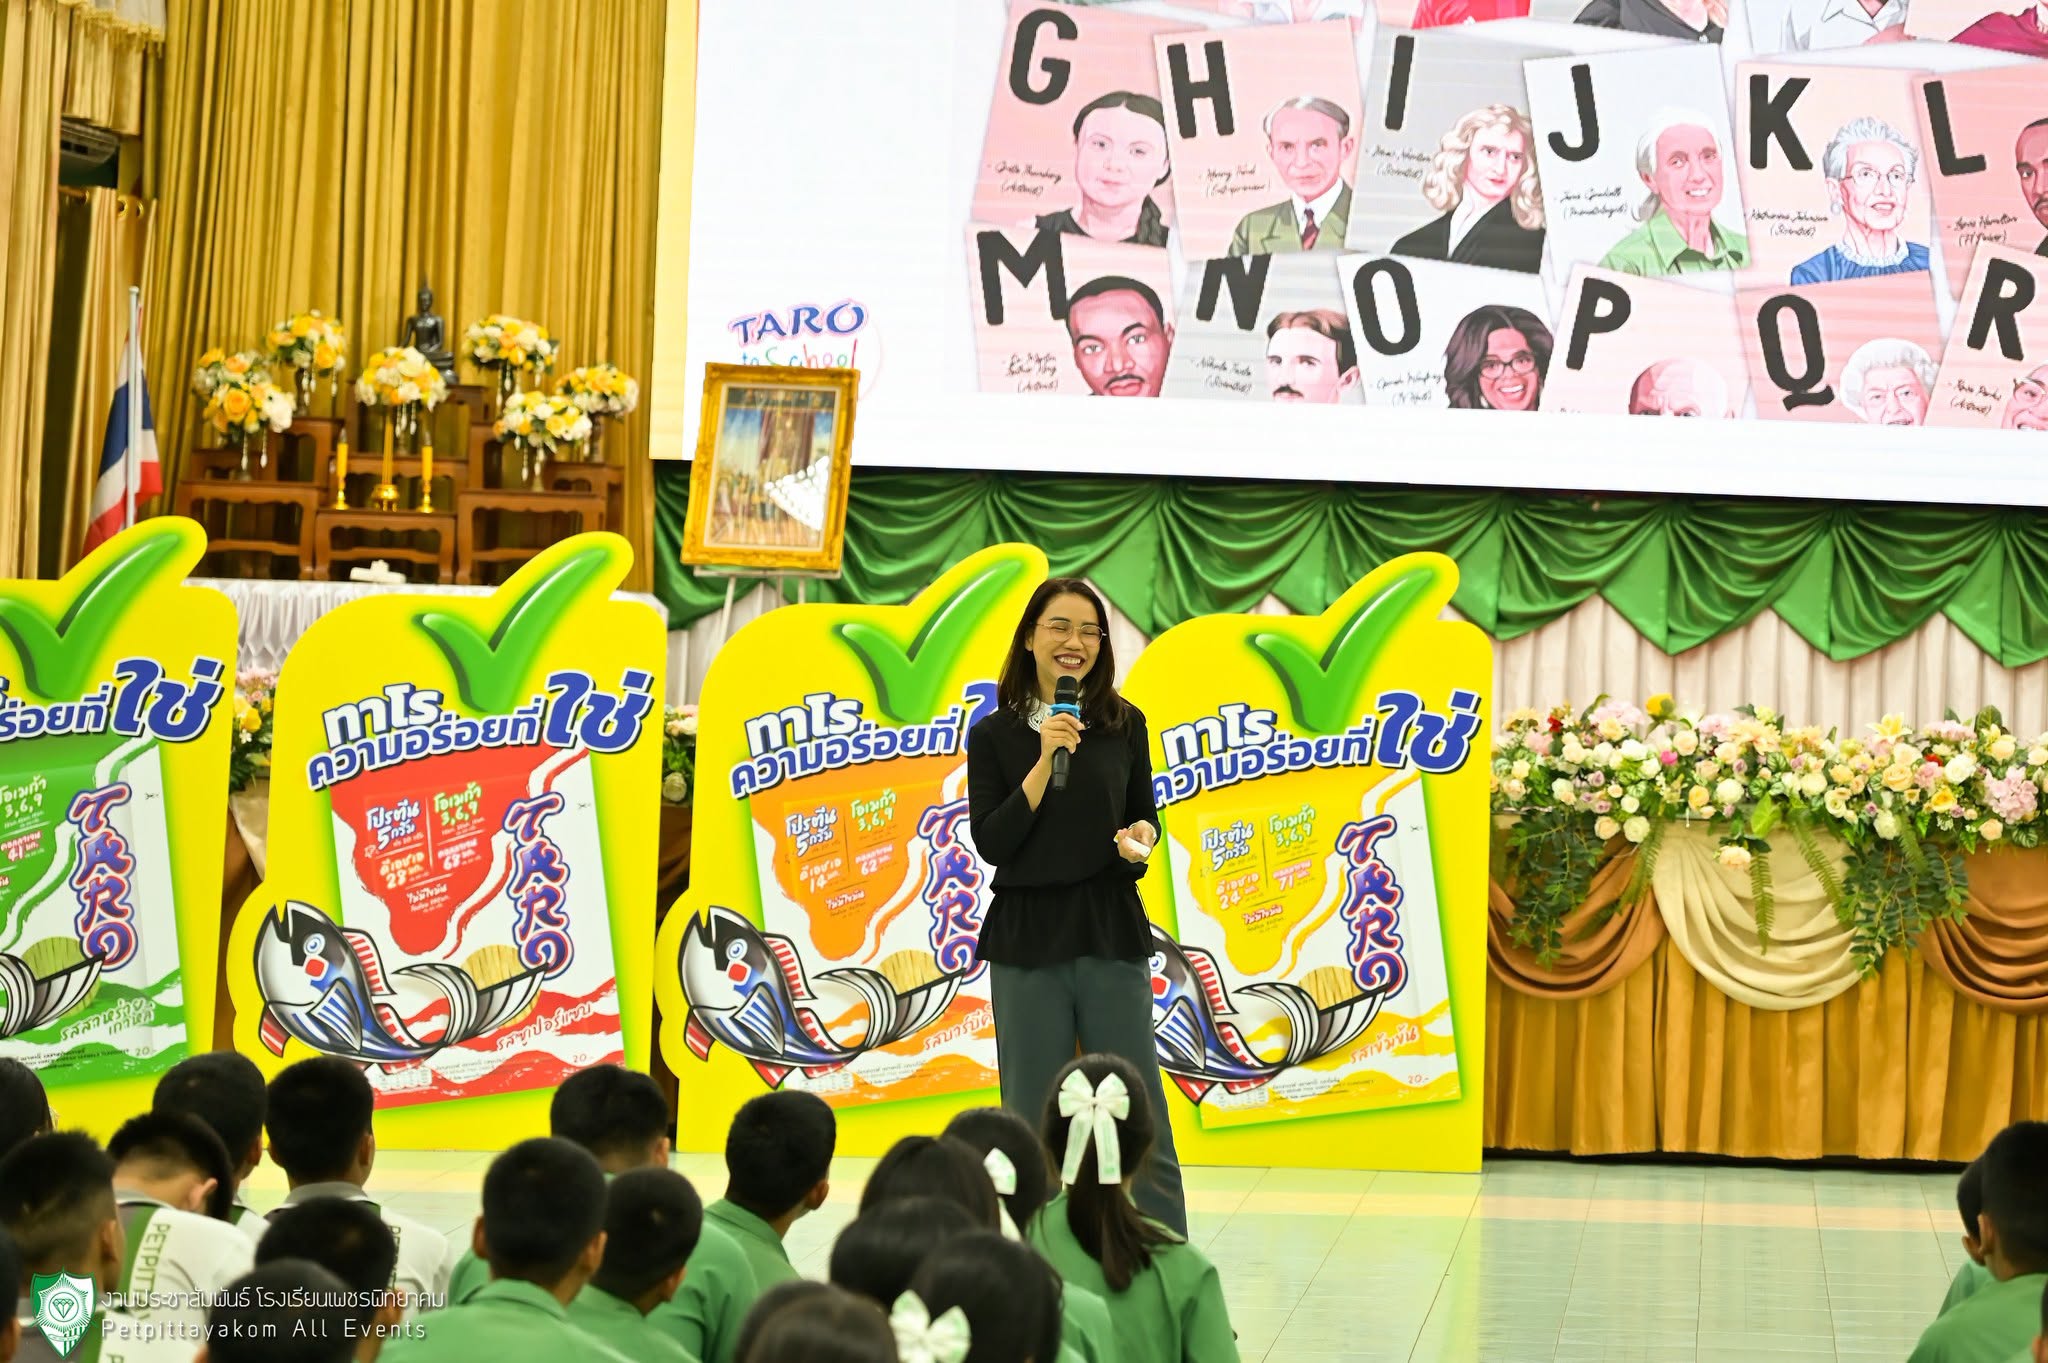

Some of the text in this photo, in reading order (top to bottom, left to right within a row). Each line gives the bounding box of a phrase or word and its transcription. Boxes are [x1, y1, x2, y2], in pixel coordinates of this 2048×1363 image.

[1009, 9, 1077, 104] G
[1168, 40, 1234, 138] H
[1385, 36, 1414, 130] I
[1548, 64, 1600, 161] J
[1749, 74, 1813, 170] K
[1923, 80, 1986, 176] L
[731, 300, 867, 345] TARO
[977, 231, 1069, 324] M
[1196, 255, 1272, 331] N
[1353, 259, 1422, 355] O
[1566, 277, 1631, 370] P
[1967, 258, 2035, 360] R
[1757, 294, 1834, 410] Q
[113, 656, 224, 742] ใช่
[306, 669, 654, 791] ความอร่อยที่ ใช่
[322, 683, 444, 750] ทาโร
[745, 692, 863, 757] ทาโร
[1162, 703, 1277, 767] ทาโร
[1376, 688, 1482, 773] ใช่
[730, 704, 965, 800] ความอร่อยที่
[366, 799, 420, 831] โปรตีน
[785, 806, 838, 838] โปรตีน
[1200, 820, 1254, 852] โปรตีน
[67, 783, 138, 971] TARO
[502, 792, 574, 980] TARO
[917, 798, 988, 984] TARO
[1335, 814, 1408, 1000] TARO
